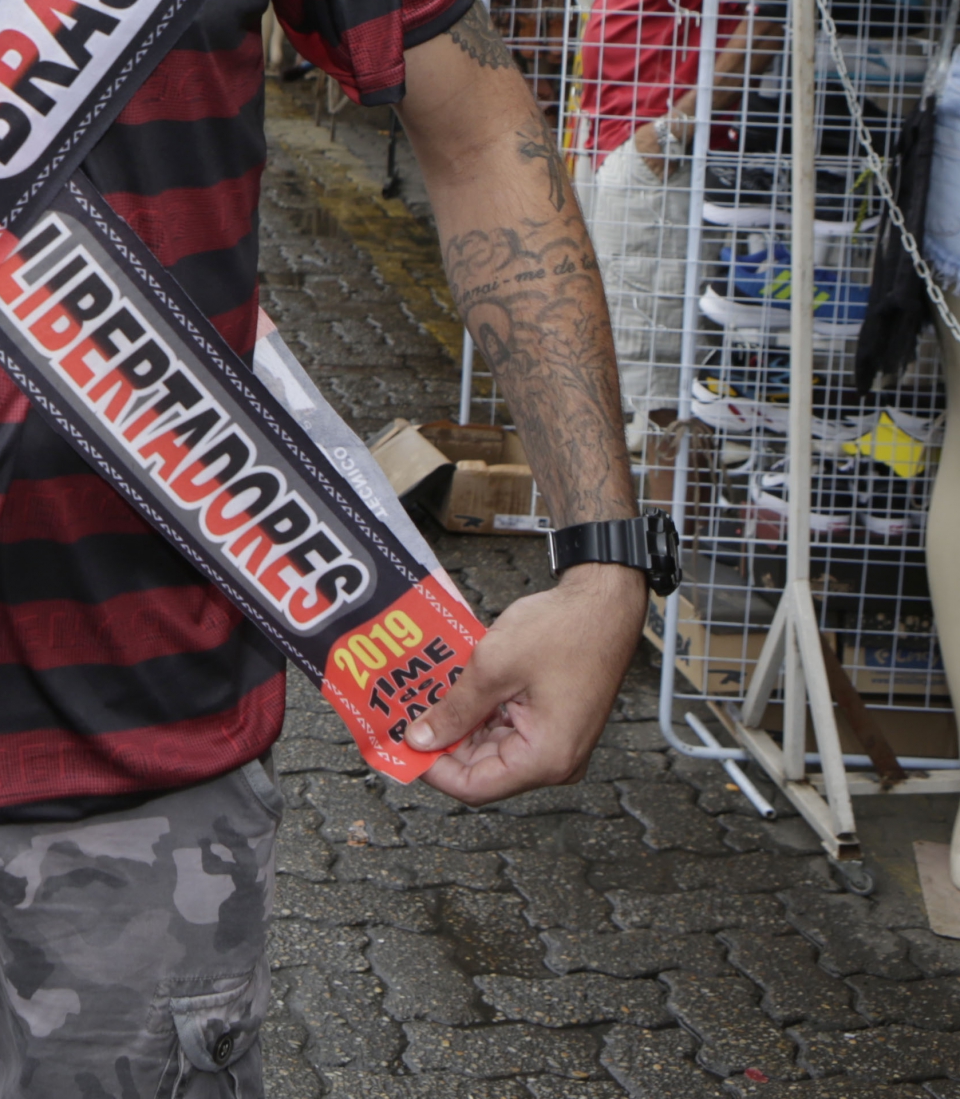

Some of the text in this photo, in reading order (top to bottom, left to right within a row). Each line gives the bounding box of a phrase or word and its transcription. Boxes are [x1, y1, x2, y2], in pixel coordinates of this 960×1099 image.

[334, 609, 424, 691] 2019
[368, 636, 456, 718] TIME
[399, 677, 435, 704] de
